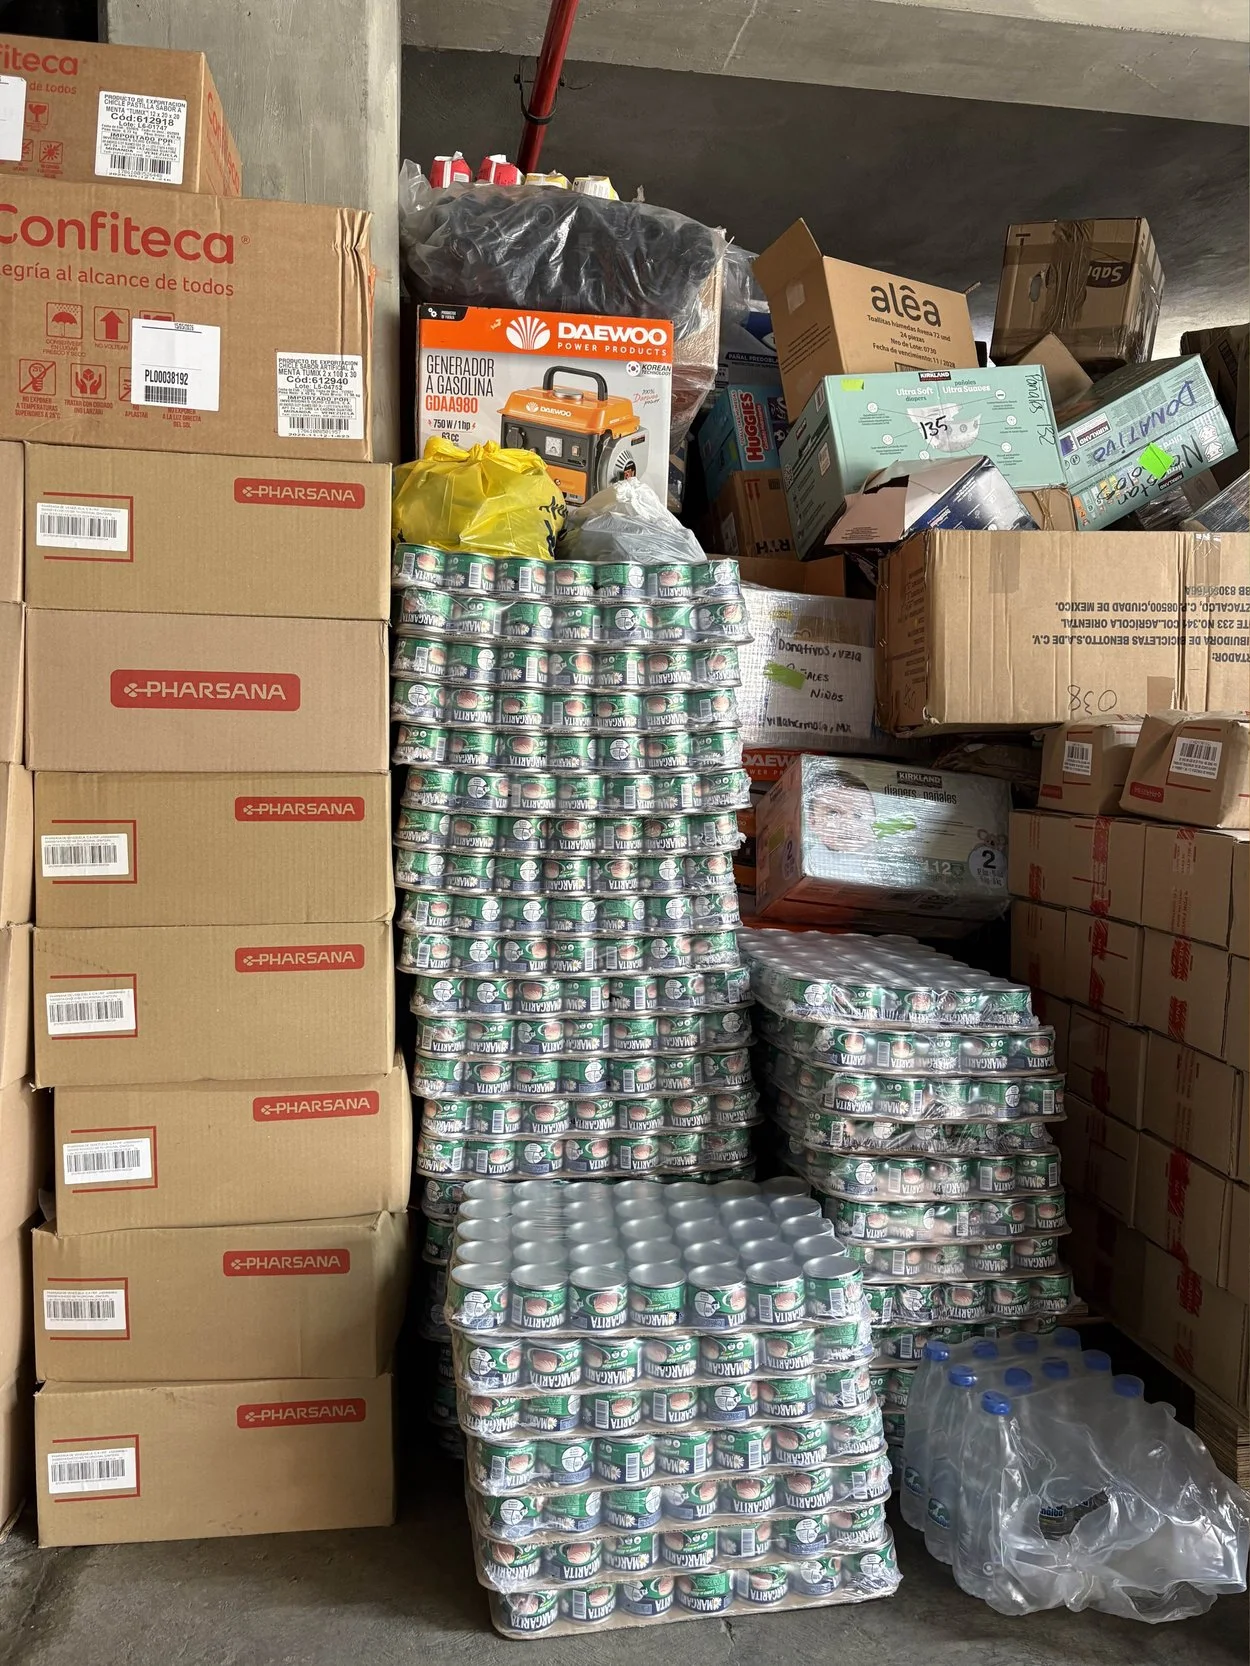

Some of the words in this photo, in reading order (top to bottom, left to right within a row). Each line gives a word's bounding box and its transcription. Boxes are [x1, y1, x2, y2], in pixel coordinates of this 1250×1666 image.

[46, 83, 77, 95] todos
[126, 101, 154, 110] PASTILLA
[0, 203, 234, 265] Confiteca
[0, 262, 50, 281] egría
[56, 265, 72, 281] al
[78, 267, 150, 288] alcance
[155, 273, 177, 291] de
[184, 277, 234, 297] todos
[870, 282, 941, 327] alêa
[867, 315, 891, 326] Toallitas
[558, 322, 667, 346] DAEWOO
[908, 334, 925, 343] piezas
[557, 341, 598, 353] POWER
[604, 345, 667, 356] PRODUCTS
[873, 343, 889, 352] Fecha
[426, 354, 495, 378] GENERADOR
[641, 363, 672, 374] KOREAN
[425, 376, 434, 394] A
[436, 376, 494, 397] GASOLINA
[425, 394, 478, 413] GDAA980
[540, 405, 572, 418] DAEWOO
[433, 418, 446, 429] 750
[741, 392, 765, 462] HUGGIES
[920, 416, 948, 439] 135
[1079, 425, 1109, 445] KIRKLAND
[258, 485, 356, 502] PHARSANA
[1097, 602, 1109, 612] DE
[1061, 619, 1107, 628] ORIENTAL
[1217, 619, 1234, 629] 233
[1189, 635, 1201, 645] DE
[147, 681, 286, 701] PHARSANA
[899, 772, 941, 783] KIRKLAND
[923, 791, 957, 805] pañales
[259, 803, 355, 816] PHARSANA
[981, 850, 996, 870] 2
[259, 951, 355, 966] PHARSANA
[276, 1097, 370, 1114] PHARSANA
[247, 1255, 341, 1270] PHARSANA
[261, 1404, 356, 1421] PHARSANA
